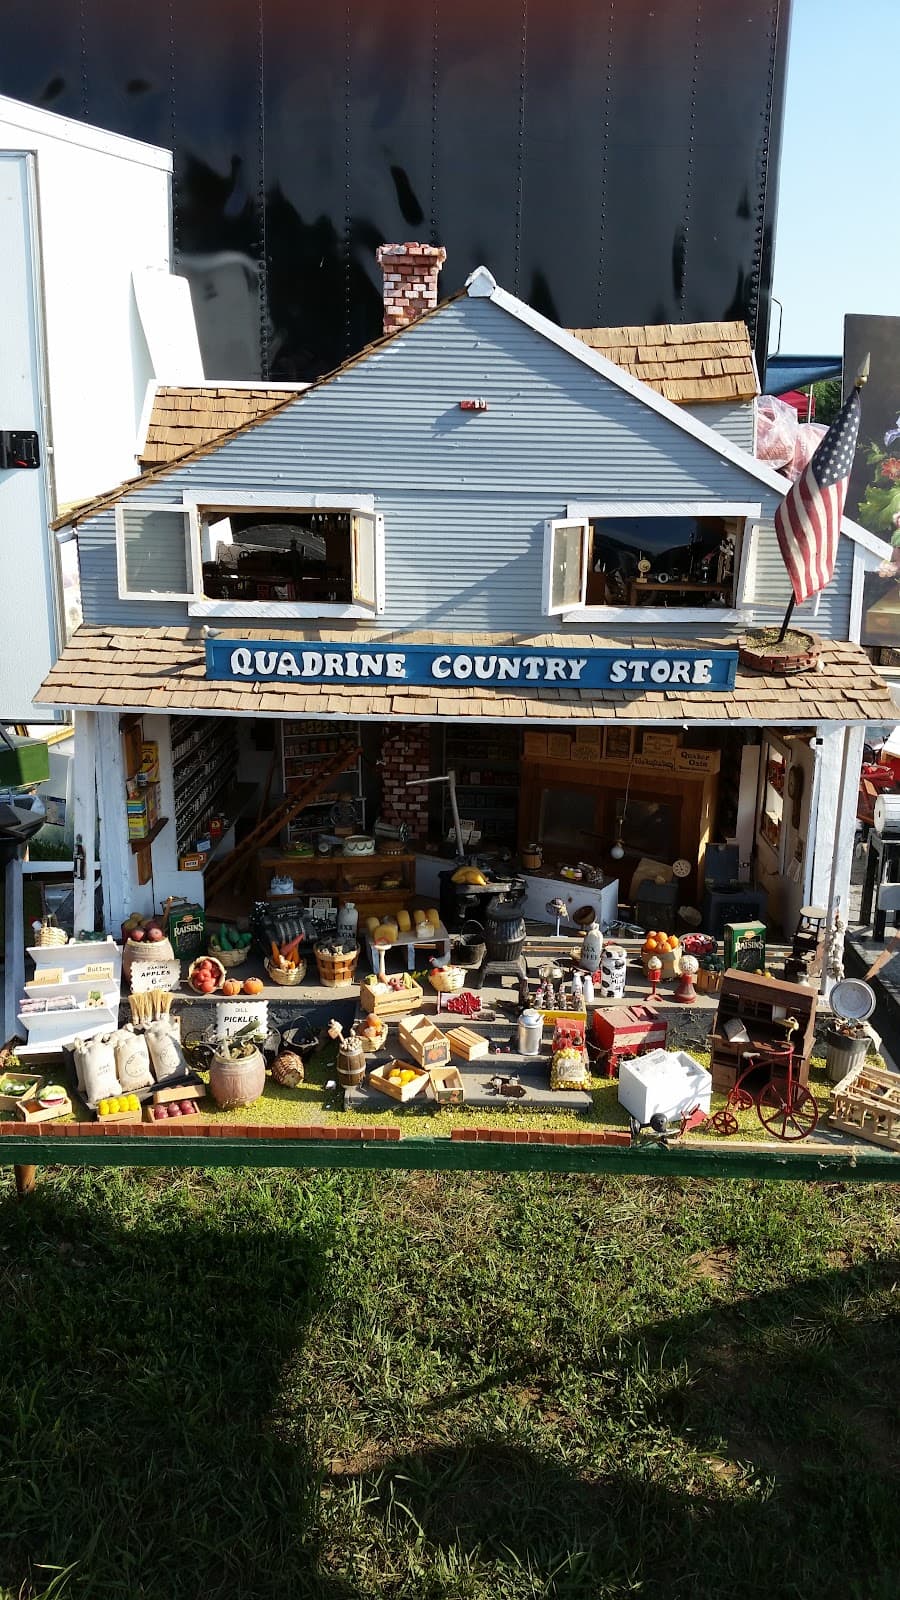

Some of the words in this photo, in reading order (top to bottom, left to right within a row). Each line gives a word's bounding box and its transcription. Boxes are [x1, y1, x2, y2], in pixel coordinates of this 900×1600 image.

[230, 647, 407, 679] QUADRINE
[431, 655, 588, 681] COUNTRY
[609, 658, 713, 684] STORE
[174, 921, 204, 938] RAISINS
[734, 939, 765, 953] RAISINS
[140, 970, 171, 978] APPLES
[223, 1015, 259, 1023] PICKLES
